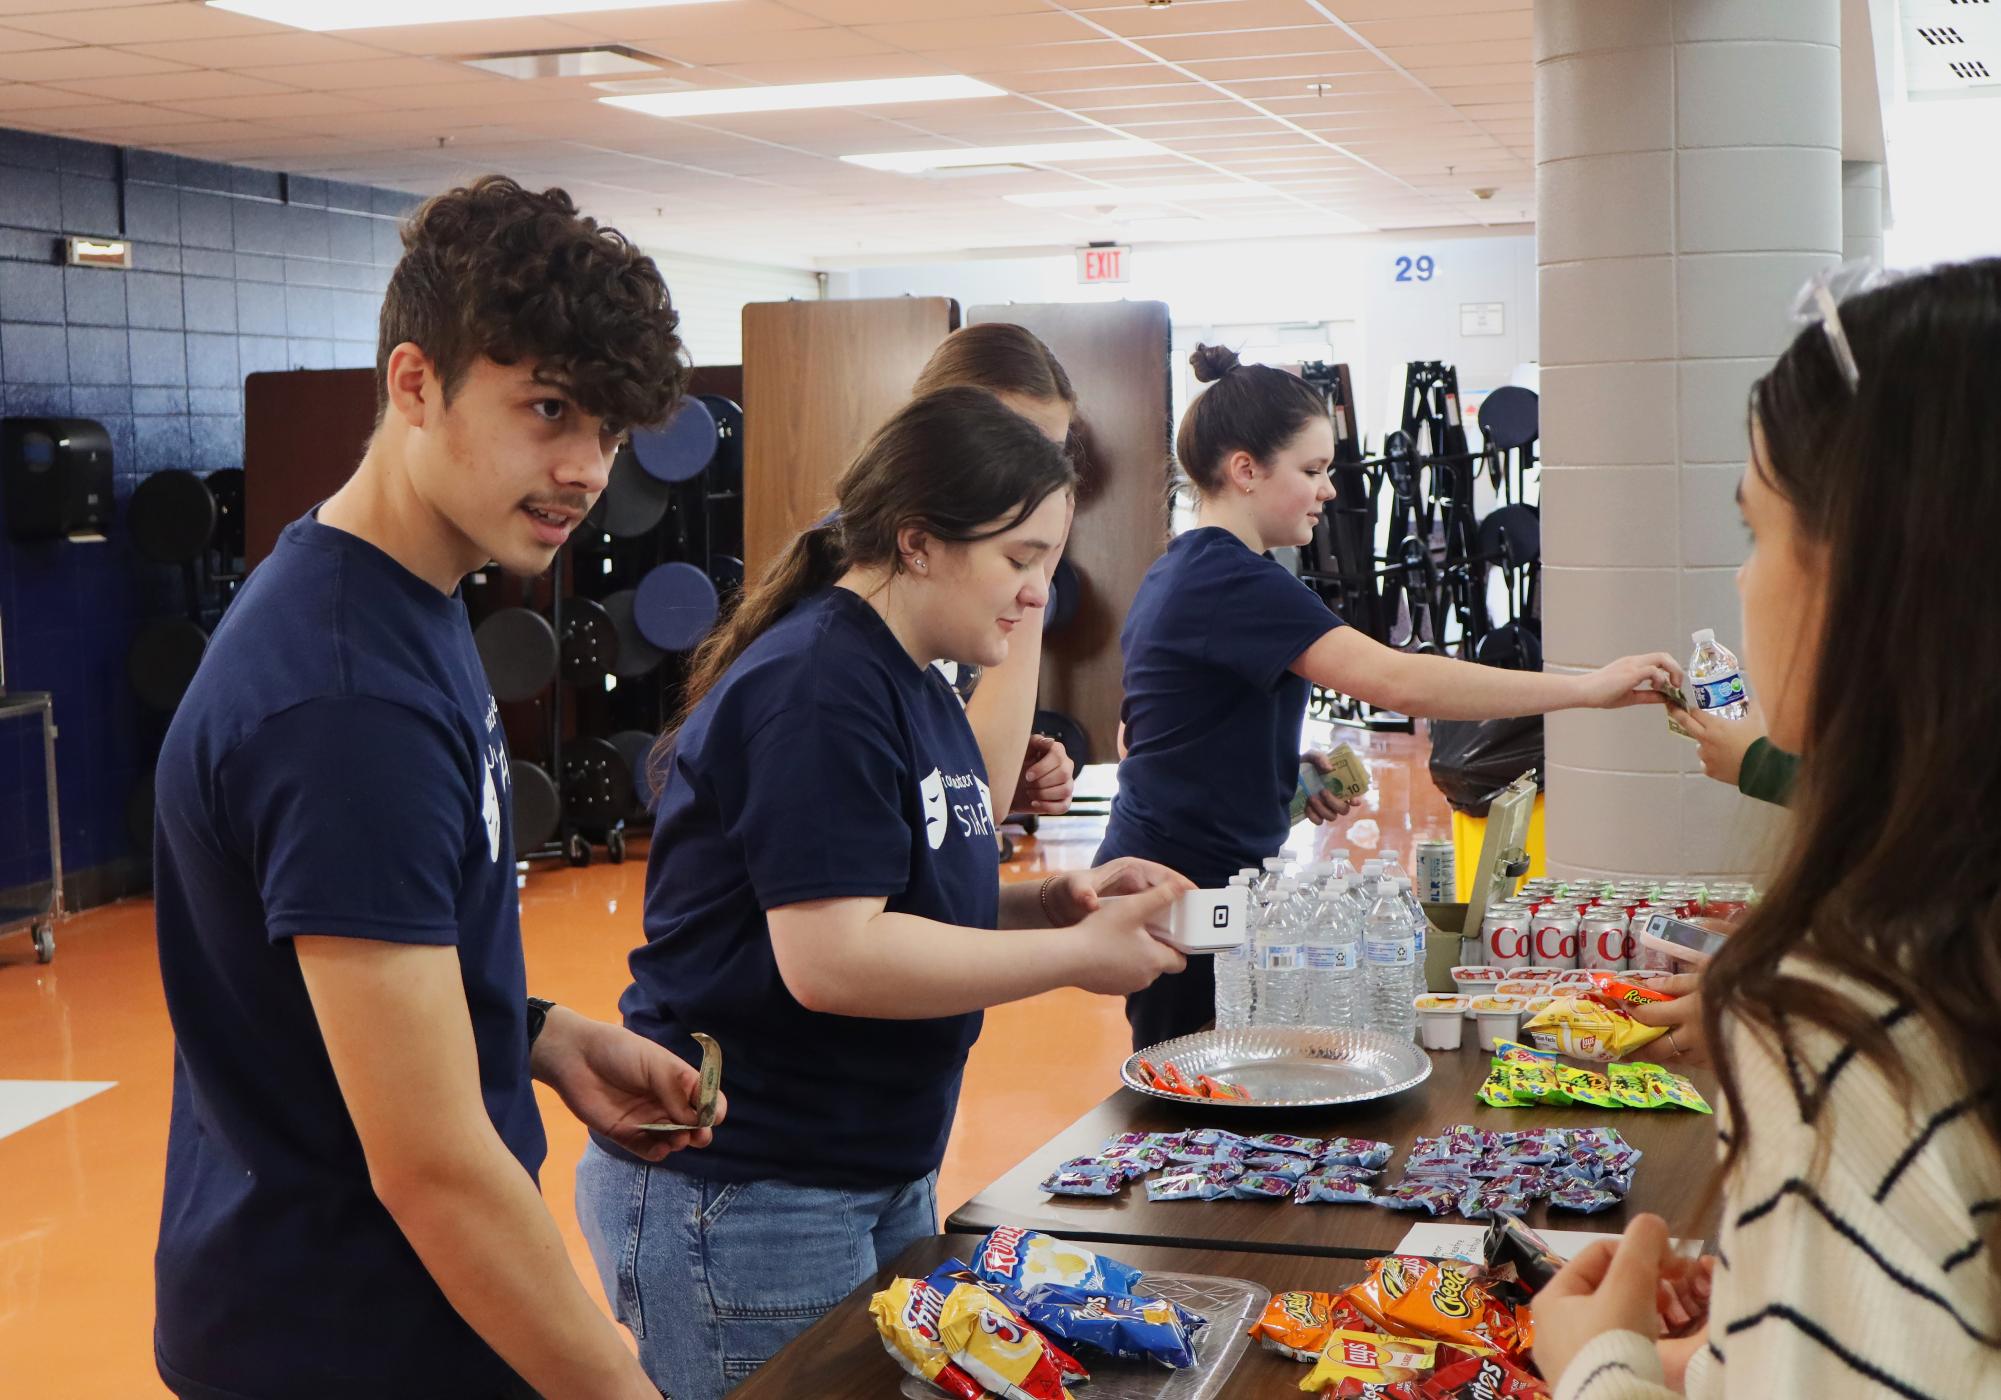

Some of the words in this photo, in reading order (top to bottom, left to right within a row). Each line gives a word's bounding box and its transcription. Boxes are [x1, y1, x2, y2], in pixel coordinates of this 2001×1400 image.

[1086, 251, 1121, 280] EXIT
[1395, 255, 1434, 281] 29
[983, 1224, 1026, 1278] RUFFLE
[1433, 1267, 1471, 1317] Cheeto
[901, 1283, 946, 1342] Frito
[1344, 1342, 1380, 1367] Lay's
